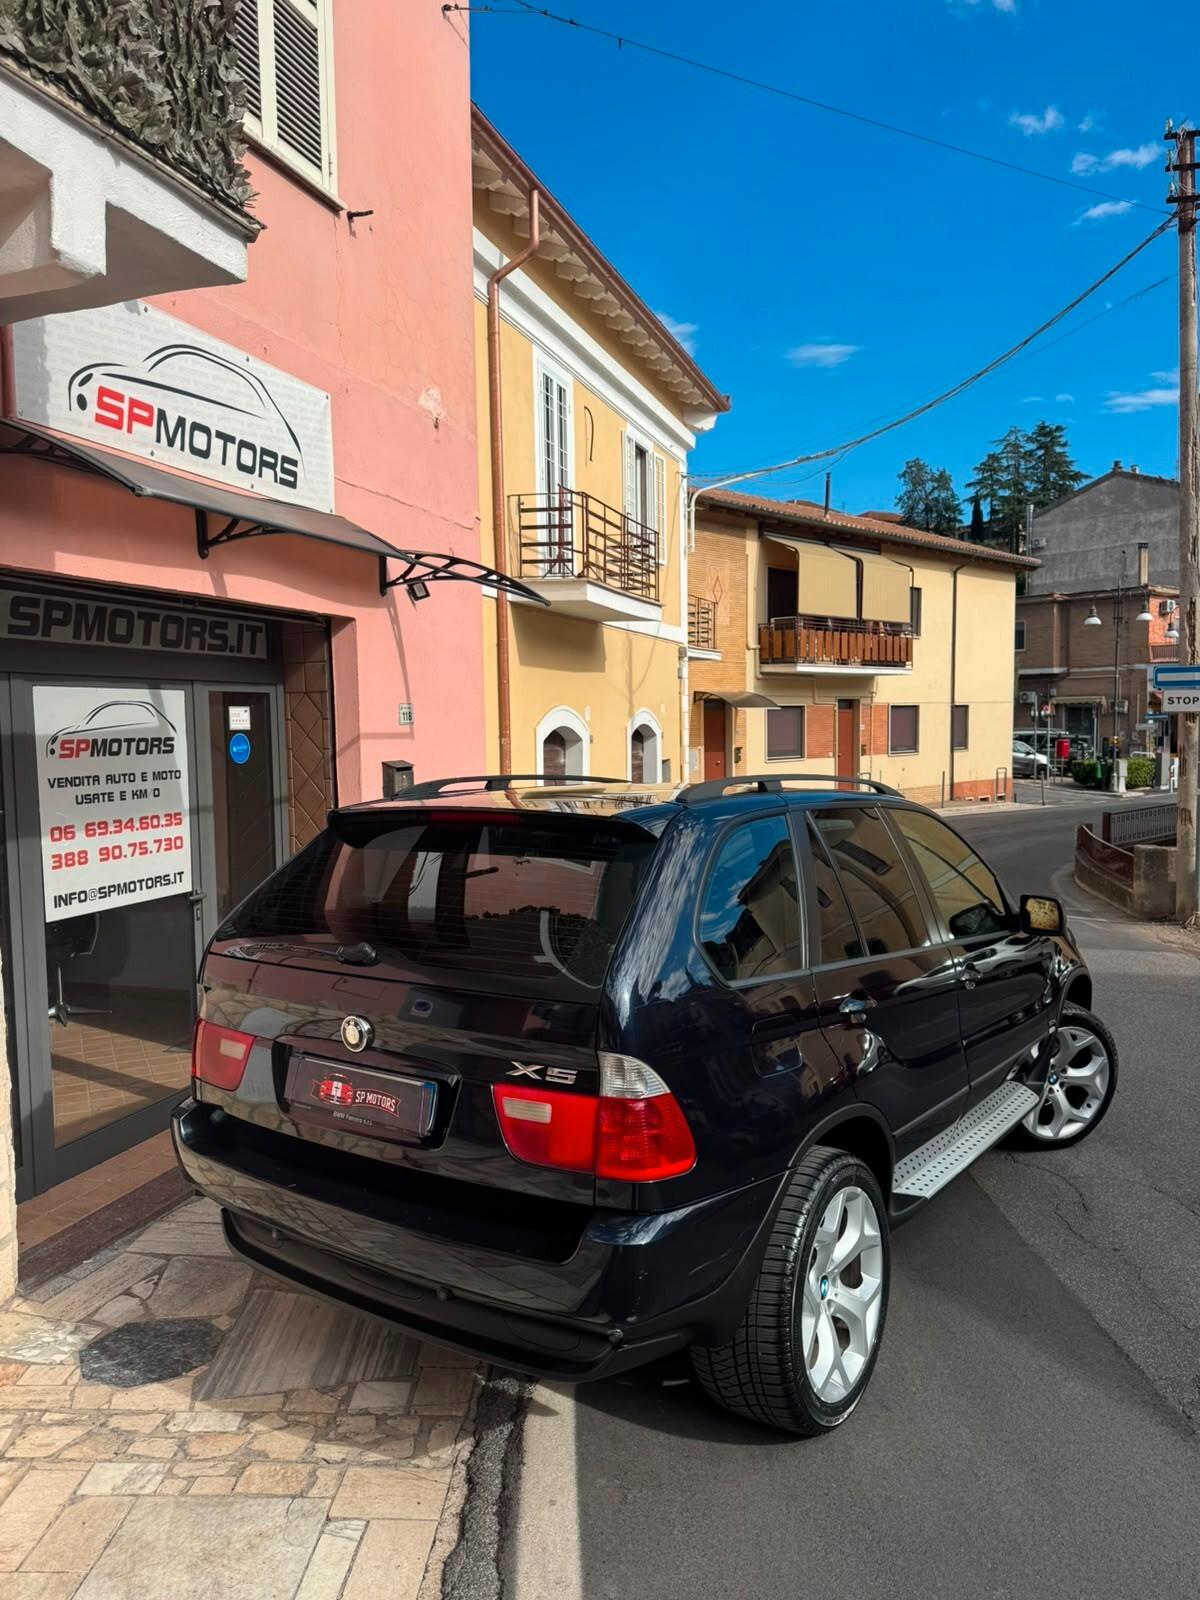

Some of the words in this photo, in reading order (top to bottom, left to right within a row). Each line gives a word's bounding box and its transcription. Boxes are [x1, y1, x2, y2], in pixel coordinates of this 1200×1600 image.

[94, 384, 299, 490] SPMOTORS
[7, 595, 264, 655] SPMOTORS.IT
[1167, 696, 1200, 705] STOP
[58, 736, 176, 760] SPMOTORS
[48, 774, 100, 789] VENDITA
[105, 772, 136, 785] AUTO
[141, 771, 148, 782] E
[152, 769, 182, 782] MOTO
[75, 791, 115, 805] USATE
[119, 790, 127, 801] E
[131, 788, 148, 801] KM
[49, 824, 76, 843] 06
[84, 812, 183, 839] 69.34.60.35
[51, 849, 89, 871] 388
[98, 835, 184, 863] 90.75.730
[53, 871, 185, 909] INFO@SPMOTORS.IT
[505, 1061, 579, 1085] X5
[355, 1090, 366, 1103] SP
[366, 1091, 396, 1112] MOTORS
